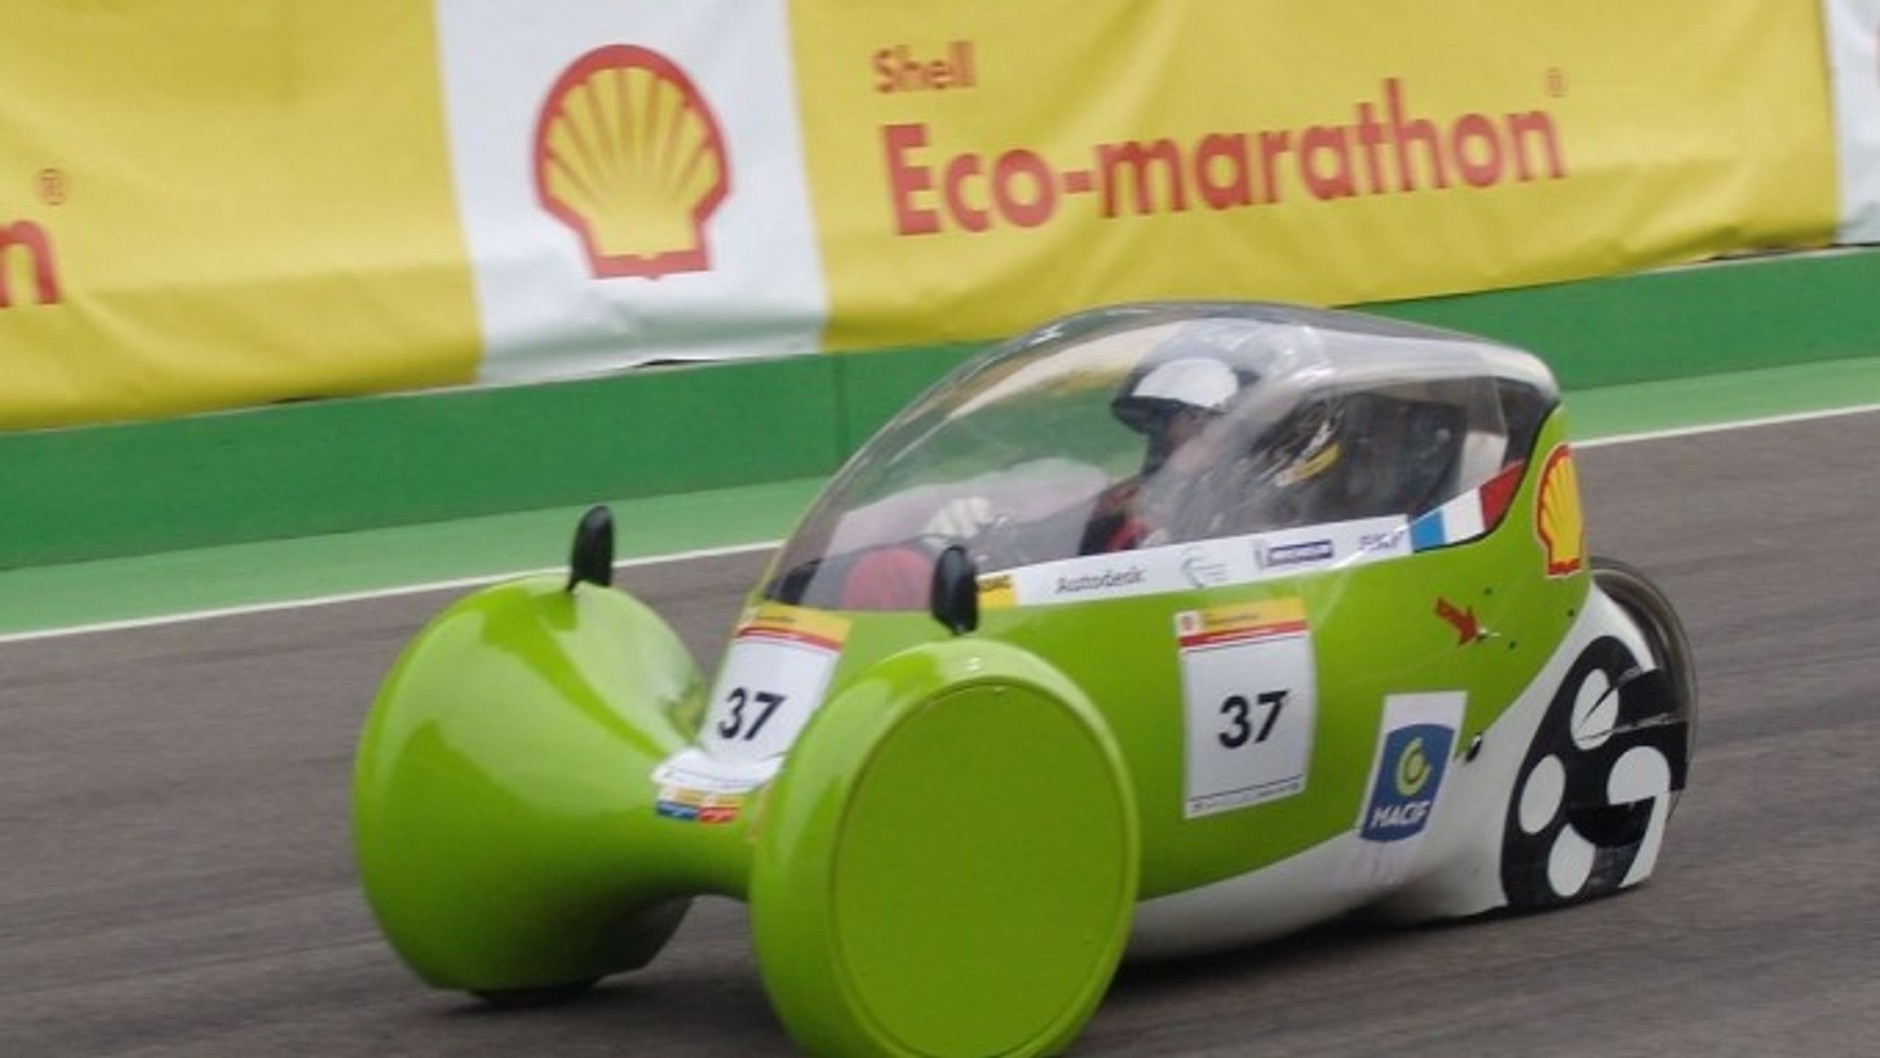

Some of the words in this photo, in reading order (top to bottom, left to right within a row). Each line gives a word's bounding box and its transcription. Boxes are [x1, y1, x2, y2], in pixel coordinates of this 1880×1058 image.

[872, 41, 977, 95] Shell
[881, 77, 1566, 237] Eco-marathon
[716, 687, 787, 742] 37
[1217, 689, 1290, 750] 37
